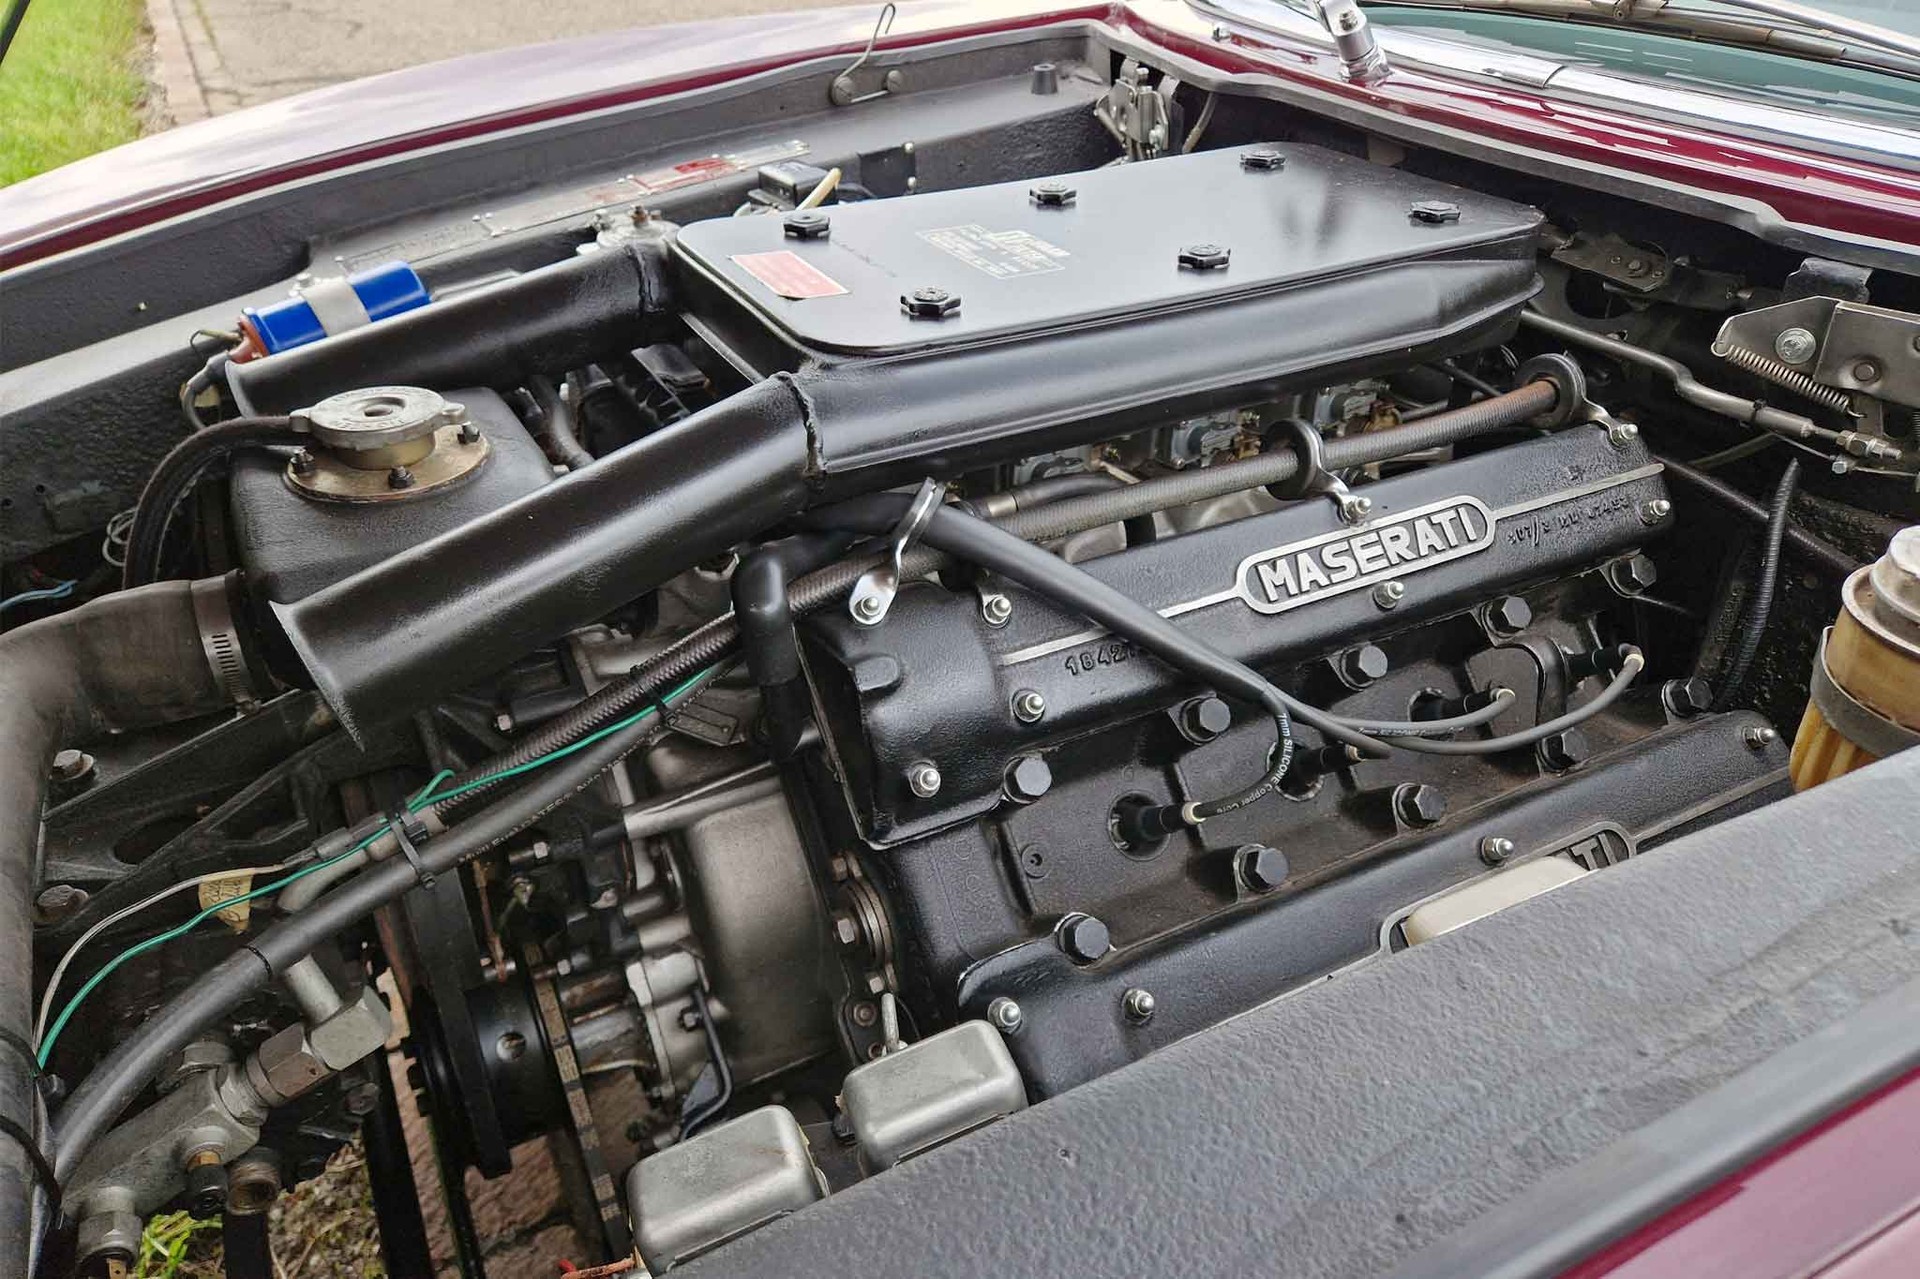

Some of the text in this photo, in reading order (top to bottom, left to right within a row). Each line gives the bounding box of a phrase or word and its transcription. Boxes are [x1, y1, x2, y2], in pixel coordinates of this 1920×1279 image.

[1257, 506, 1478, 602] MASERATI
[1270, 738, 1294, 786] SILICONE
[1241, 783, 1273, 806] Copper
